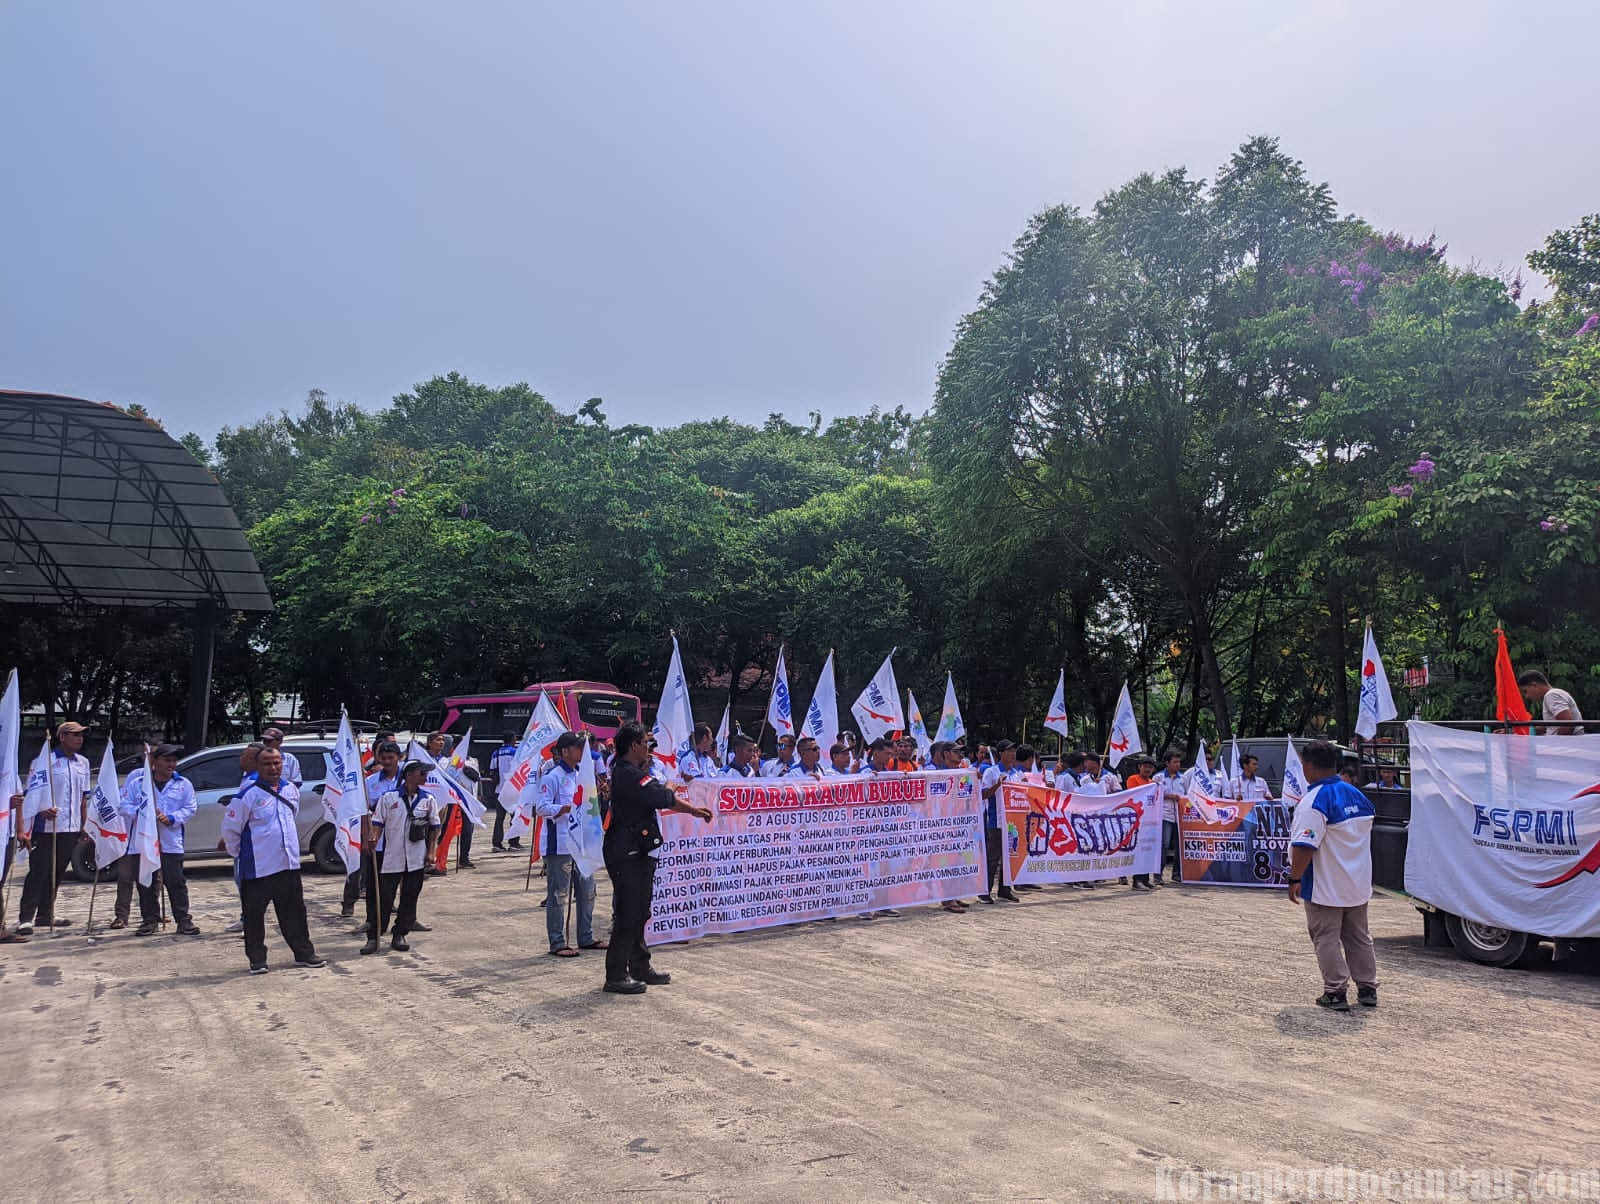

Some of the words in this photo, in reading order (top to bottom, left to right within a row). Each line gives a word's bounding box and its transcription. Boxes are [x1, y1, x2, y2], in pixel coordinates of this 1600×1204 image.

[719, 785, 799, 811] SUARA
[803, 781, 865, 807] KAUM
[868, 778, 927, 803] BURUH
[737, 832, 771, 844] SATGAS
[773, 831, 791, 842] PHK
[799, 828, 832, 840] SAHKAN
[833, 827, 850, 837] RUU
[851, 822, 899, 836] PERAMPASAN
[919, 817, 951, 830] BERANTAS
[952, 815, 979, 827] KORUPSI
[748, 815, 762, 827] 28
[766, 810, 819, 827] AGUSTUS
[852, 804, 908, 820] PEKANBARU
[1473, 804, 1578, 846] FSPMI
[657, 853, 704, 869] EFORMSI
[733, 846, 792, 860] PERBURUHAN
[798, 842, 834, 854] NAIKKAN
[835, 840, 856, 852] PTKP
[747, 861, 778, 873] HAPUS
[779, 859, 806, 871] PAJAK
[807, 855, 852, 868] PESANGON,
[853, 851, 879, 863] HAPUS
[880, 849, 901, 860] PAJAK
[918, 844, 940, 856] HAPUS
[1184, 840, 1207, 852] KSPI
[1214, 841, 1245, 853] FSPMI
[1253, 850, 1272, 881] 8
[652, 885, 687, 901] HAPUS
[744, 877, 772, 888] PAJAK
[774, 871, 826, 885] PEREMPUAN
[826, 867, 862, 880] MENIKAH
[653, 900, 697, 917] SAHKAN
[747, 885, 821, 903] UNDANG-UNDANG
[914, 870, 935, 881] TANPA
[653, 916, 689, 932] REVISI
[741, 903, 787, 919] REDESAIGN
[789, 899, 820, 913] SISTEM
[821, 895, 850, 907] PEMILU
